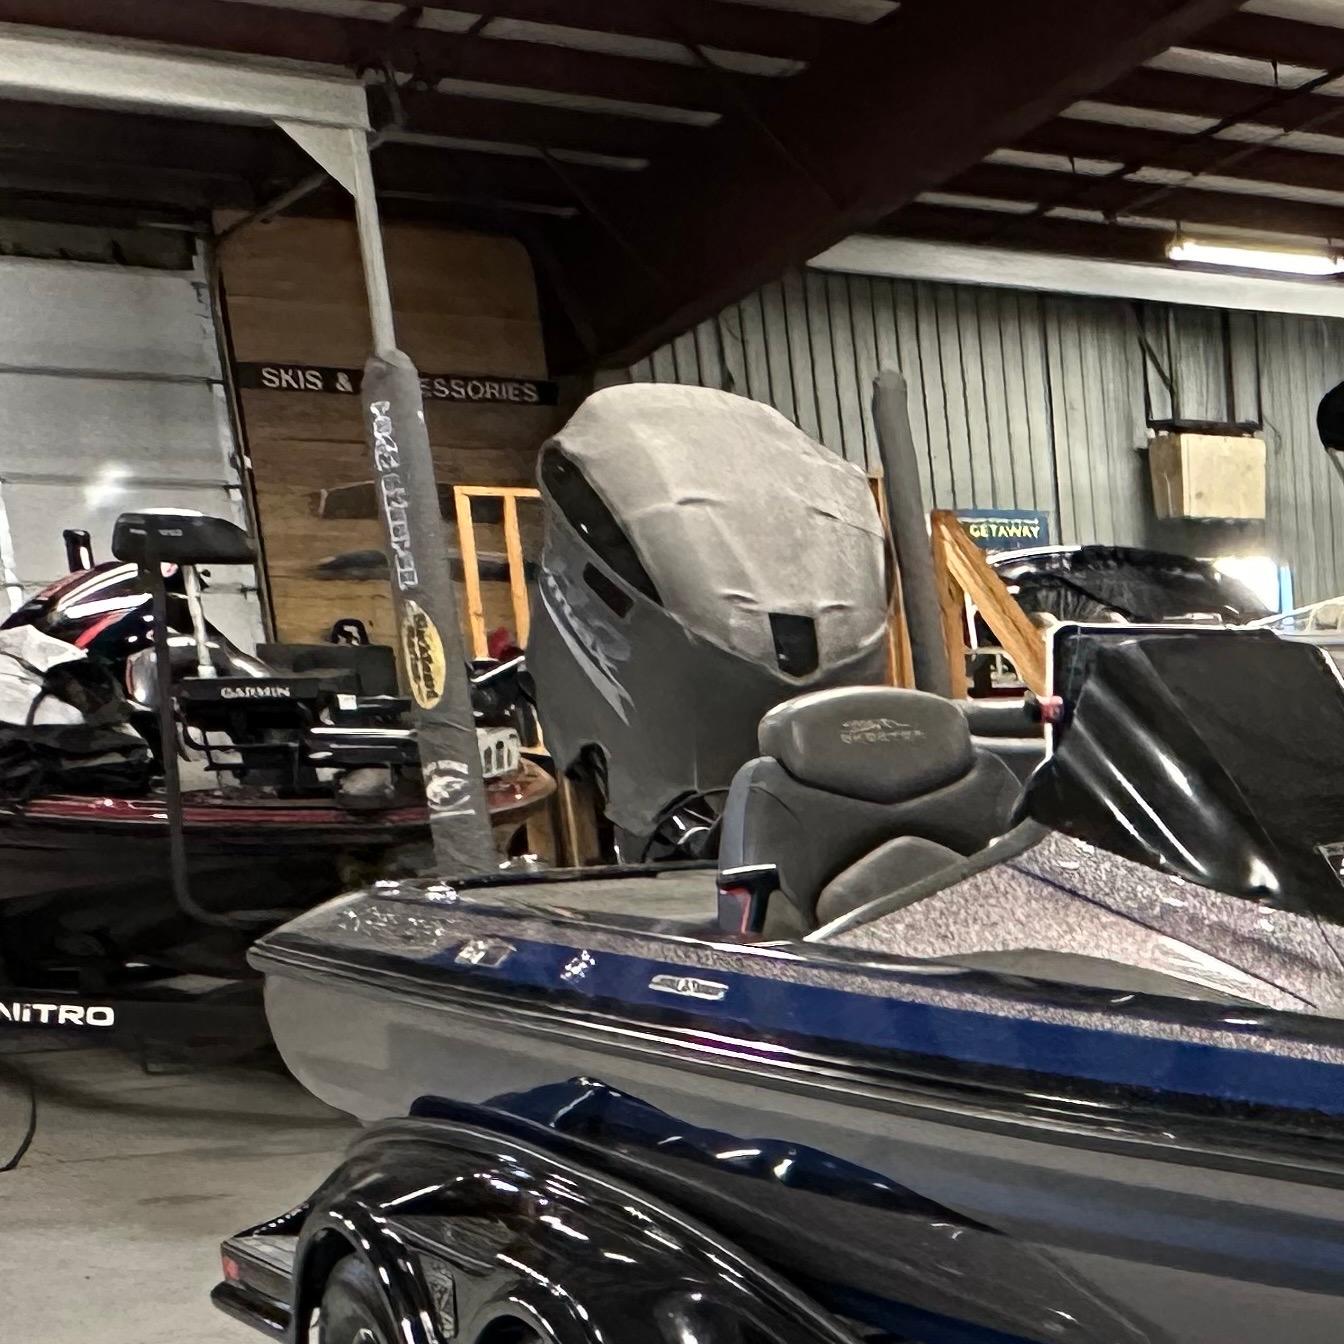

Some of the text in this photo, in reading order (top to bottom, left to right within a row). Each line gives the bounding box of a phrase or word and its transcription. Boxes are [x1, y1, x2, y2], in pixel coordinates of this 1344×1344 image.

[261, 367, 539, 402] SKIS & ESSORIES
[969, 523, 1041, 539] GETAWAY
[220, 686, 291, 699] GARMIN
